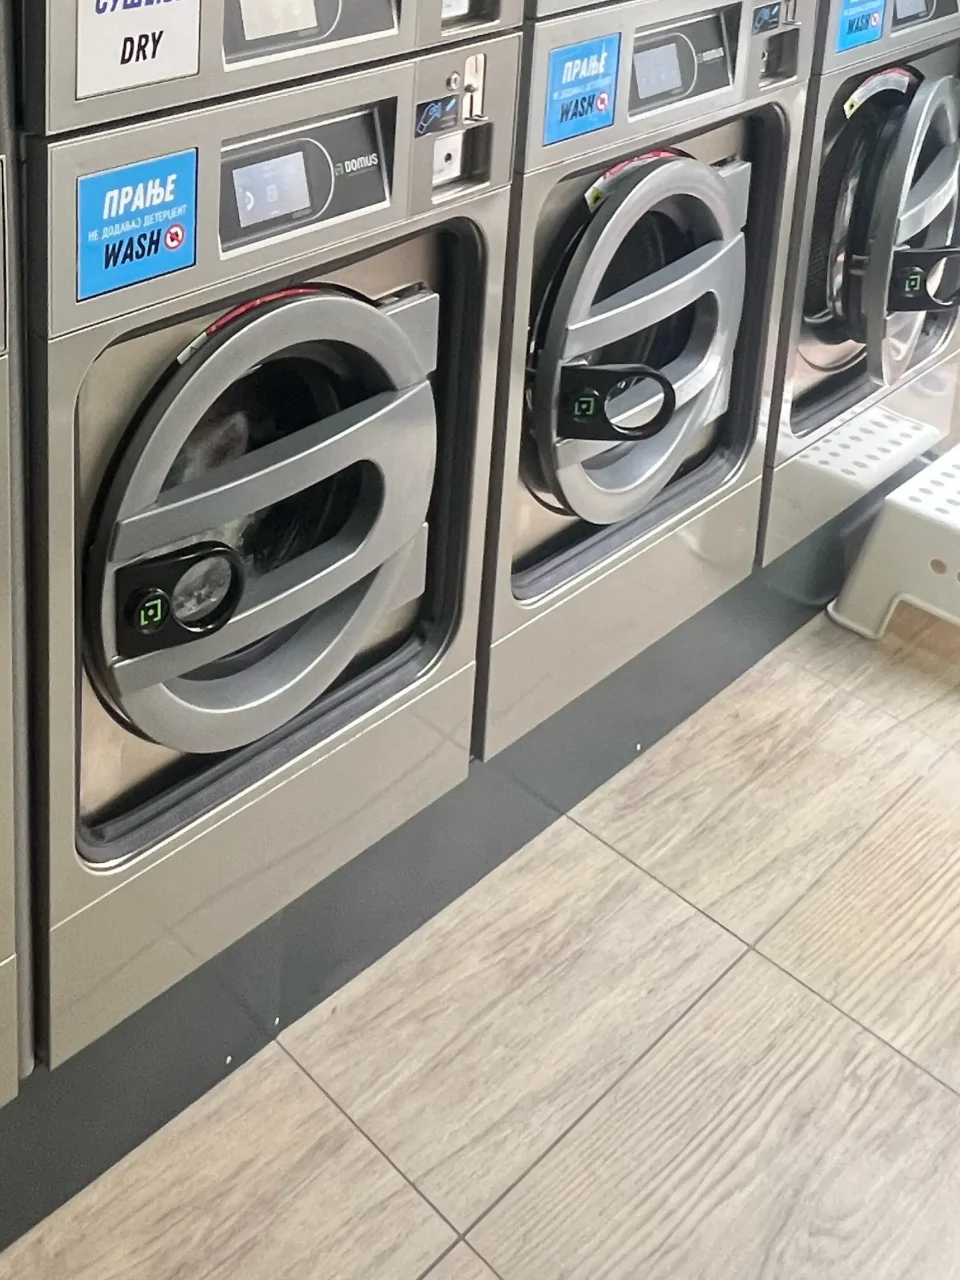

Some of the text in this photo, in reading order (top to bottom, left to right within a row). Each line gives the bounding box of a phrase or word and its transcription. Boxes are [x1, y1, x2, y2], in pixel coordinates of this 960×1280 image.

[120, 31, 164, 65] DRY
[559, 94, 596, 123] WASH
[345, 153, 378, 173] DOMUS
[103, 174, 177, 219] ПРАЊЕ
[104, 228, 162, 270] WASH
